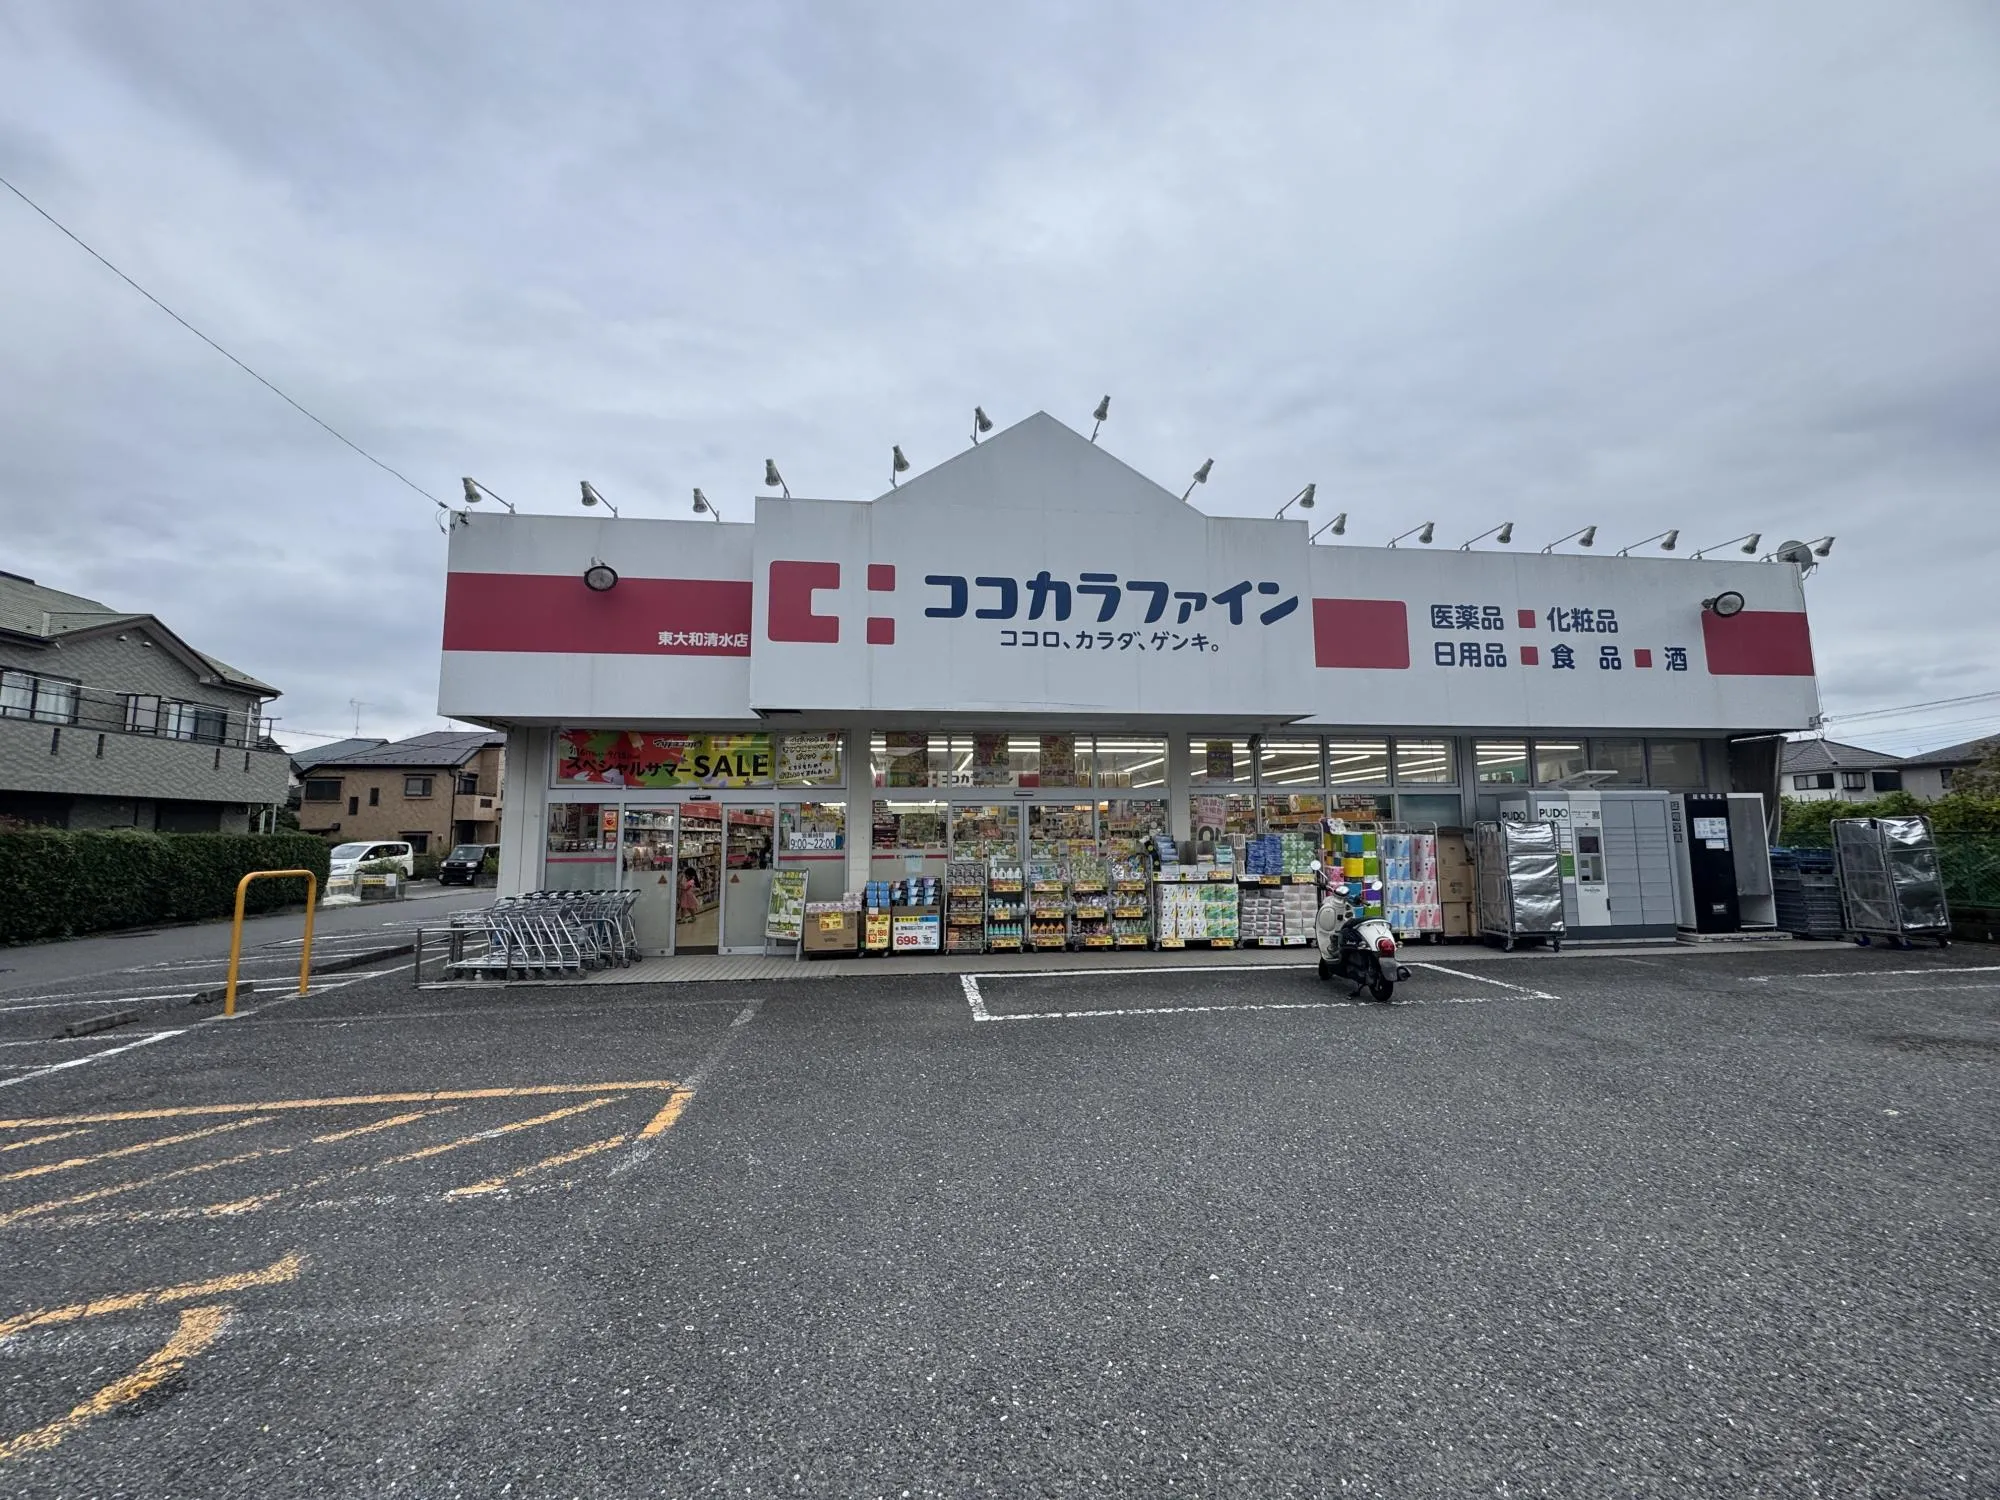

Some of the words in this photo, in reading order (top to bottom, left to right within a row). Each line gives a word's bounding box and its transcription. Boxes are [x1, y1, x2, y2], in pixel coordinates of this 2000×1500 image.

[924, 570, 1299, 626] ココカラファイン
[1430, 604, 1505, 631] 医薬品
[1546, 606, 1619, 634] 化粧品
[657, 630, 749, 648] 東大和清水店
[1000, 630, 1219, 653] ココロ、カラダ、ゲンキ。
[1434, 641, 1508, 668] 日用品
[1664, 646, 1688, 672] 酒
[1502, 811, 1526, 821] PUDO
[1539, 808, 1569, 819] PUDO
[896, 935, 919, 945] 698
